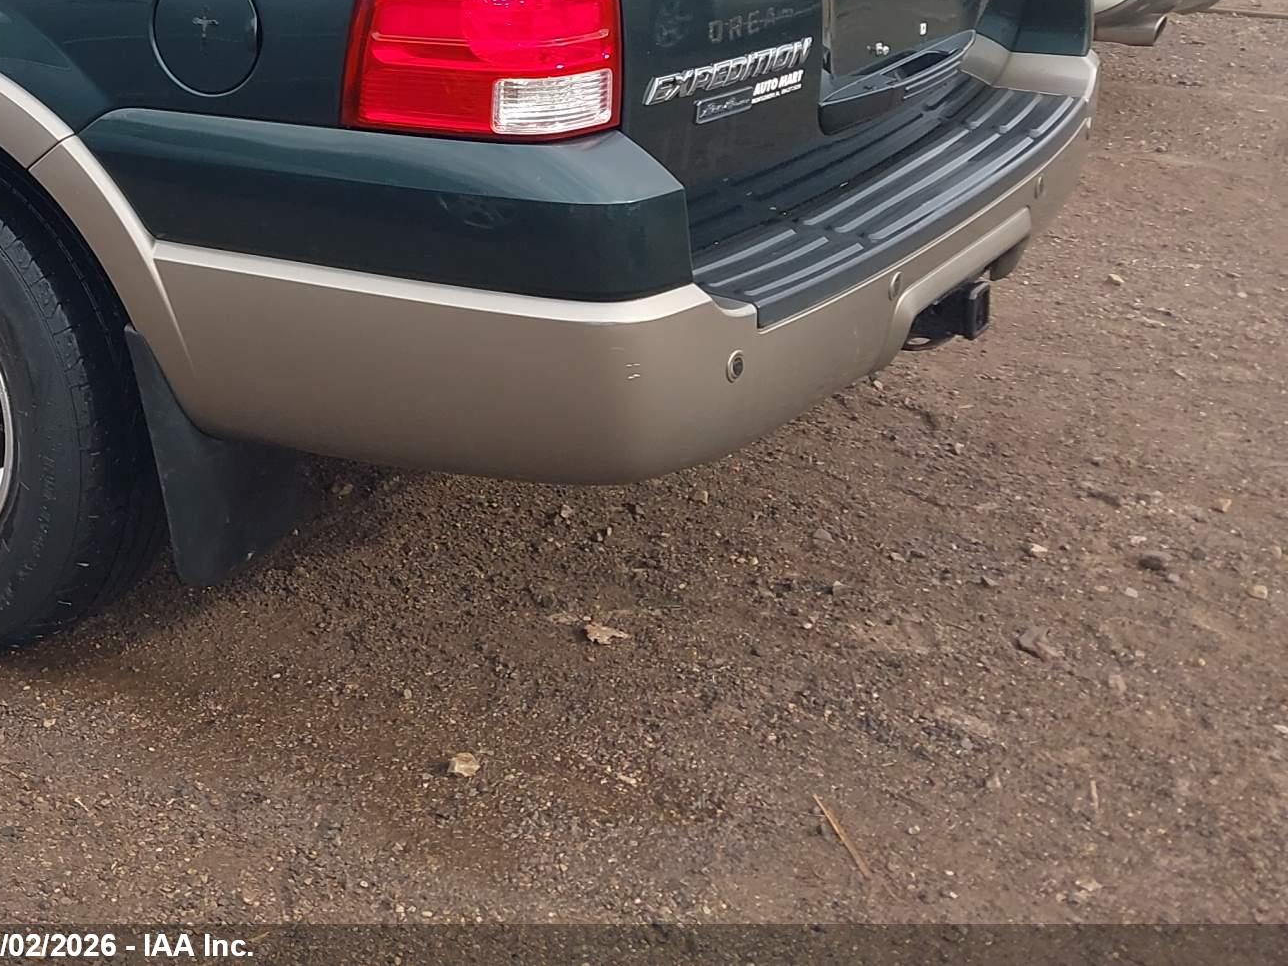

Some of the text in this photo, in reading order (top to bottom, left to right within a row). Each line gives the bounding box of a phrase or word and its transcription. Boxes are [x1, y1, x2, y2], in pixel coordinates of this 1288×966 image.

[642, 36, 813, 106] EXPEDITION
[752, 77, 779, 97] AUTO
[778, 69, 805, 89] MART
